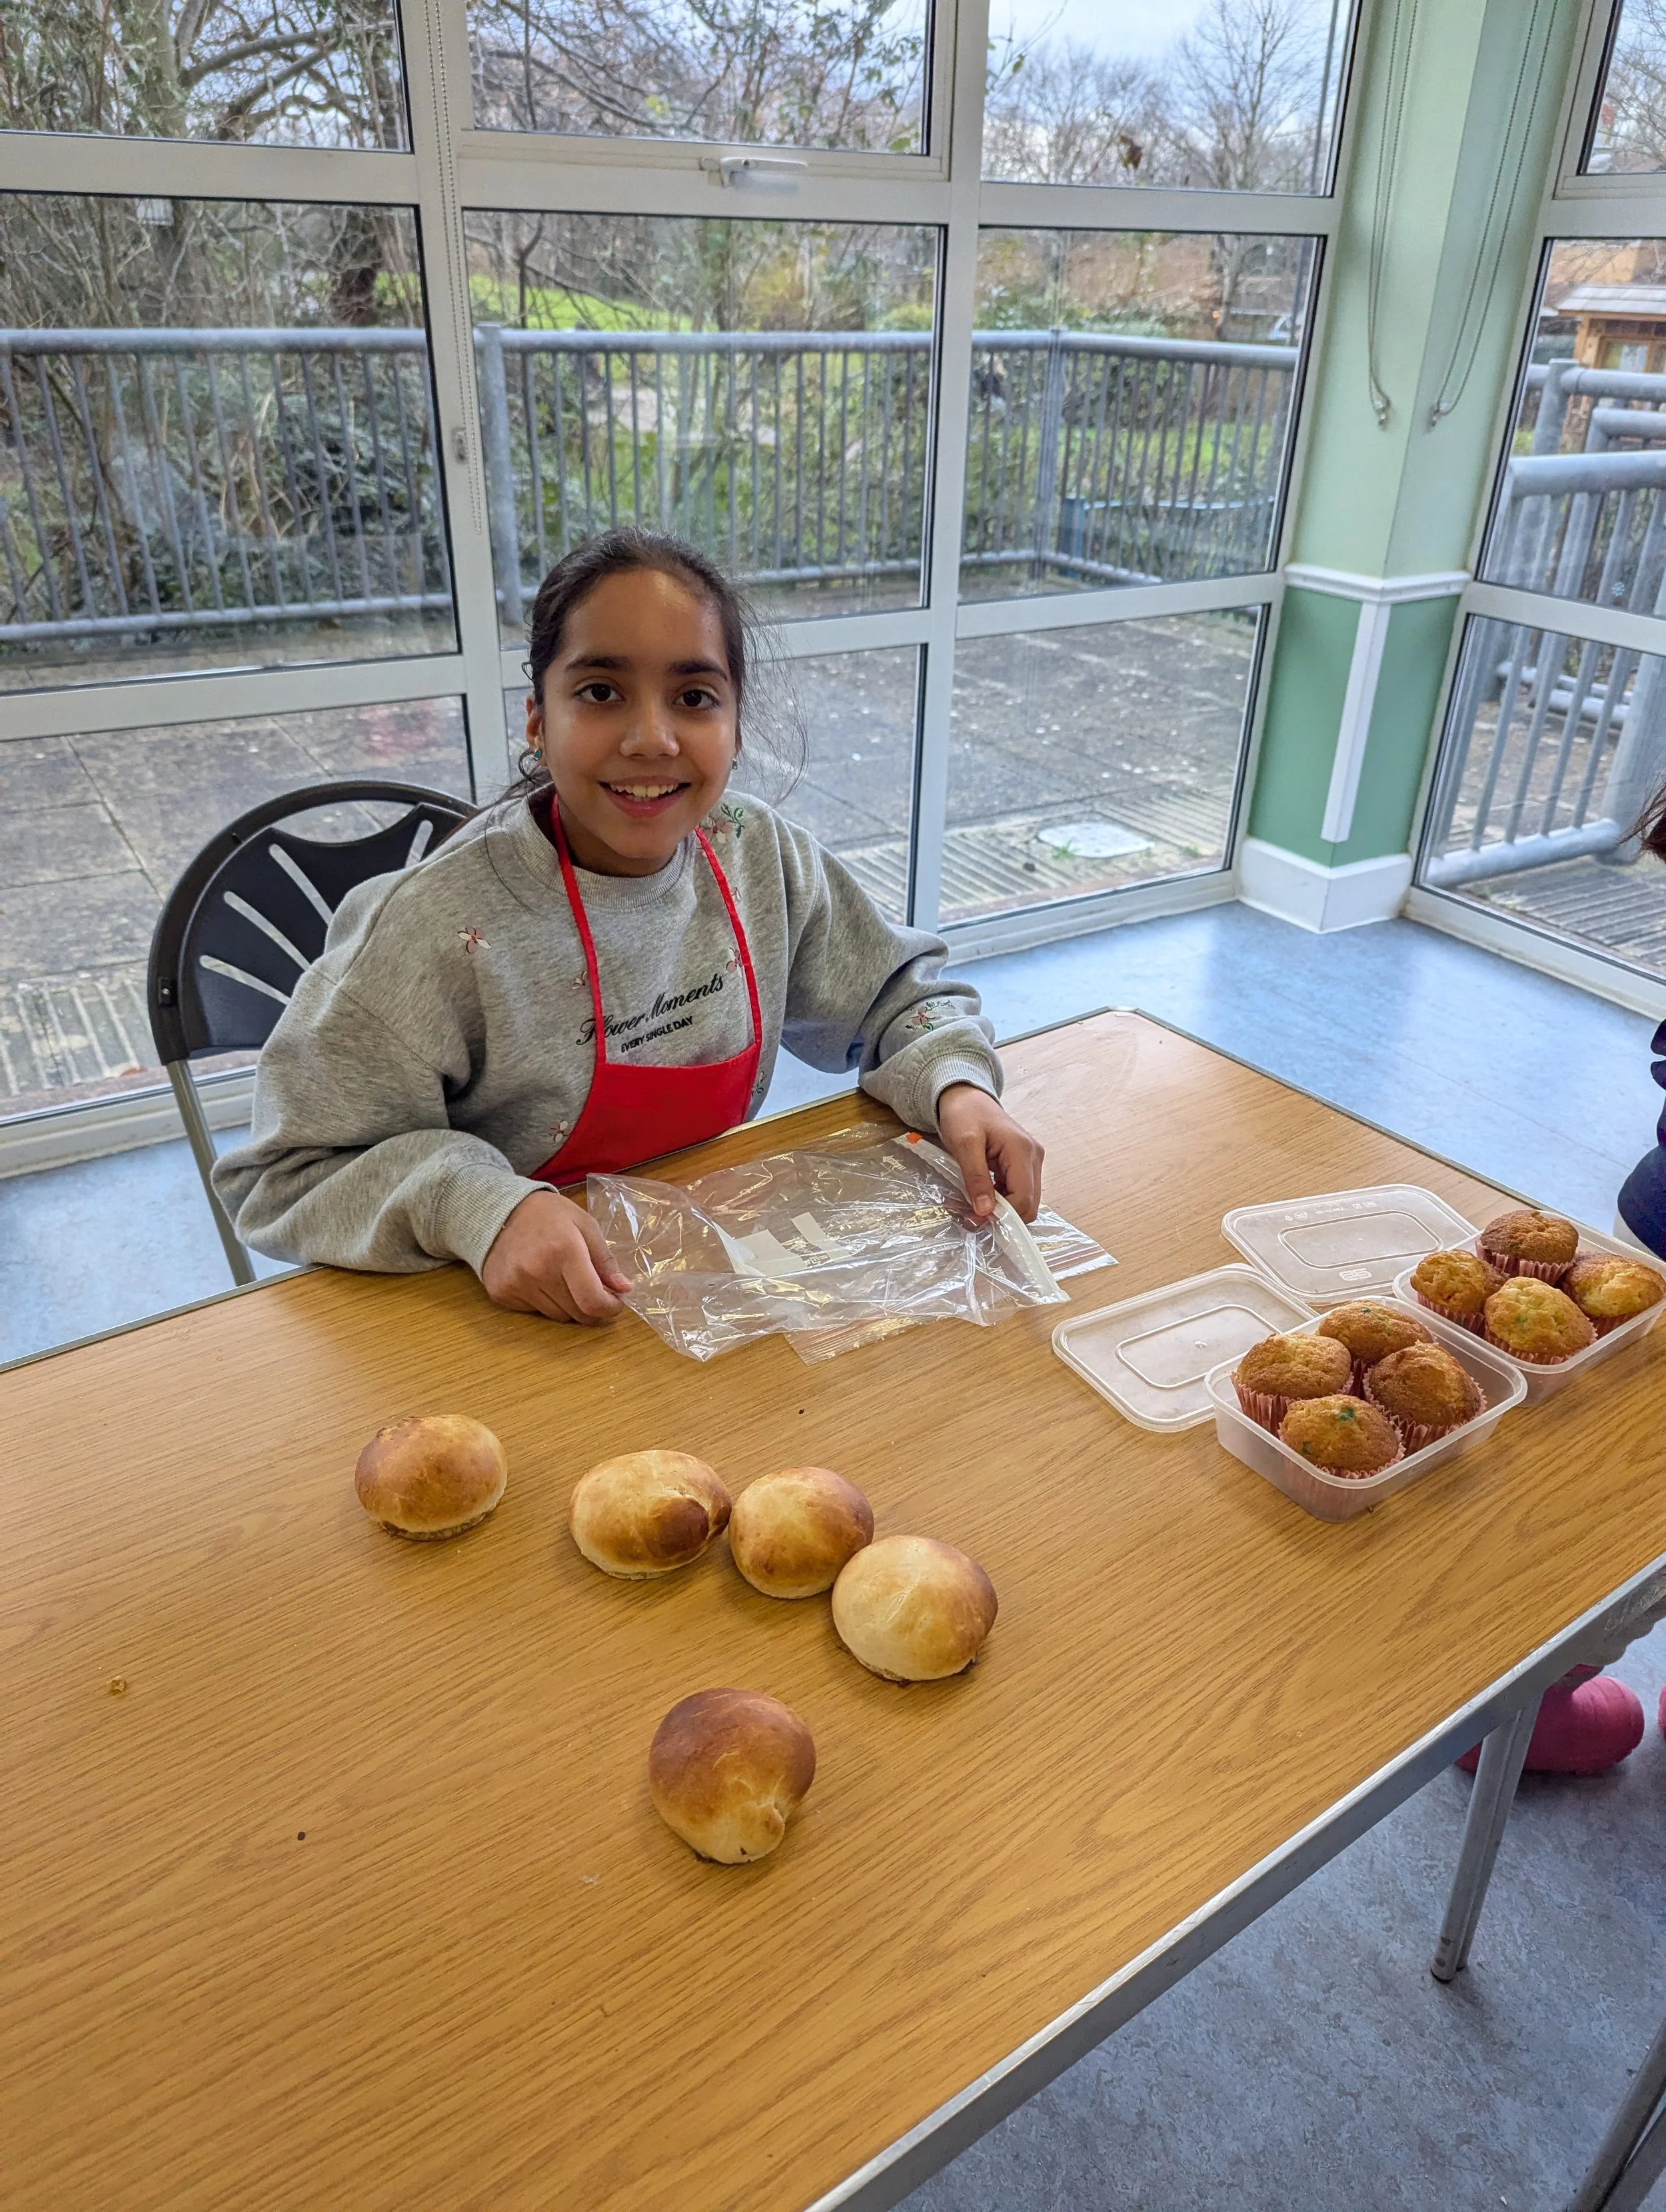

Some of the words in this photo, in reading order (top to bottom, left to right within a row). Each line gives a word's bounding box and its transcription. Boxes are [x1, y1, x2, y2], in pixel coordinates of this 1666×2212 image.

[645, 973, 723, 1021] Moments
[621, 1037, 644, 1053] EVERY
[646, 1025, 673, 1042] SINGLE
[674, 1016, 694, 1030] DAY
